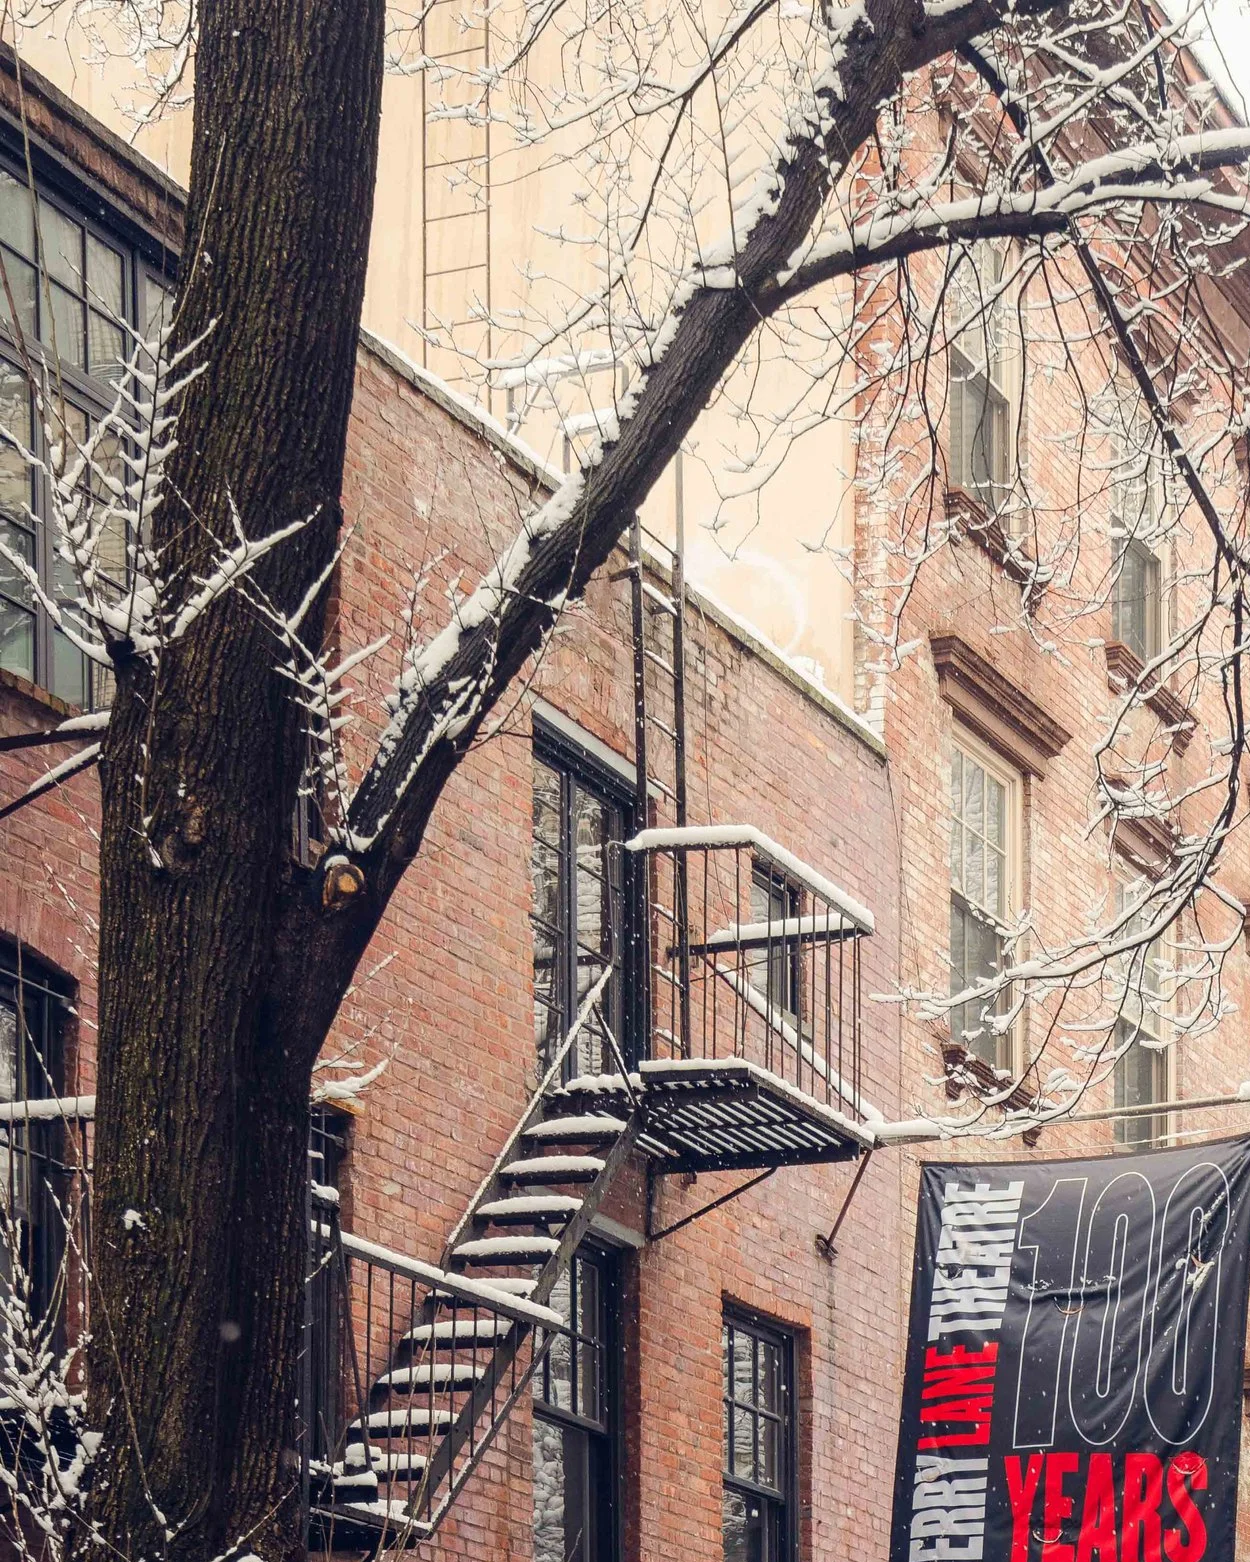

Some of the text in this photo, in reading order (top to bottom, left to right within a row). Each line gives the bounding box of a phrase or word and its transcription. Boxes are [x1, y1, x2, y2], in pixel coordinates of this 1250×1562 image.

[928, 1181, 1024, 1342] THEATRE
[1012, 1162, 1230, 1449] 100
[917, 1342, 999, 1450] LANE
